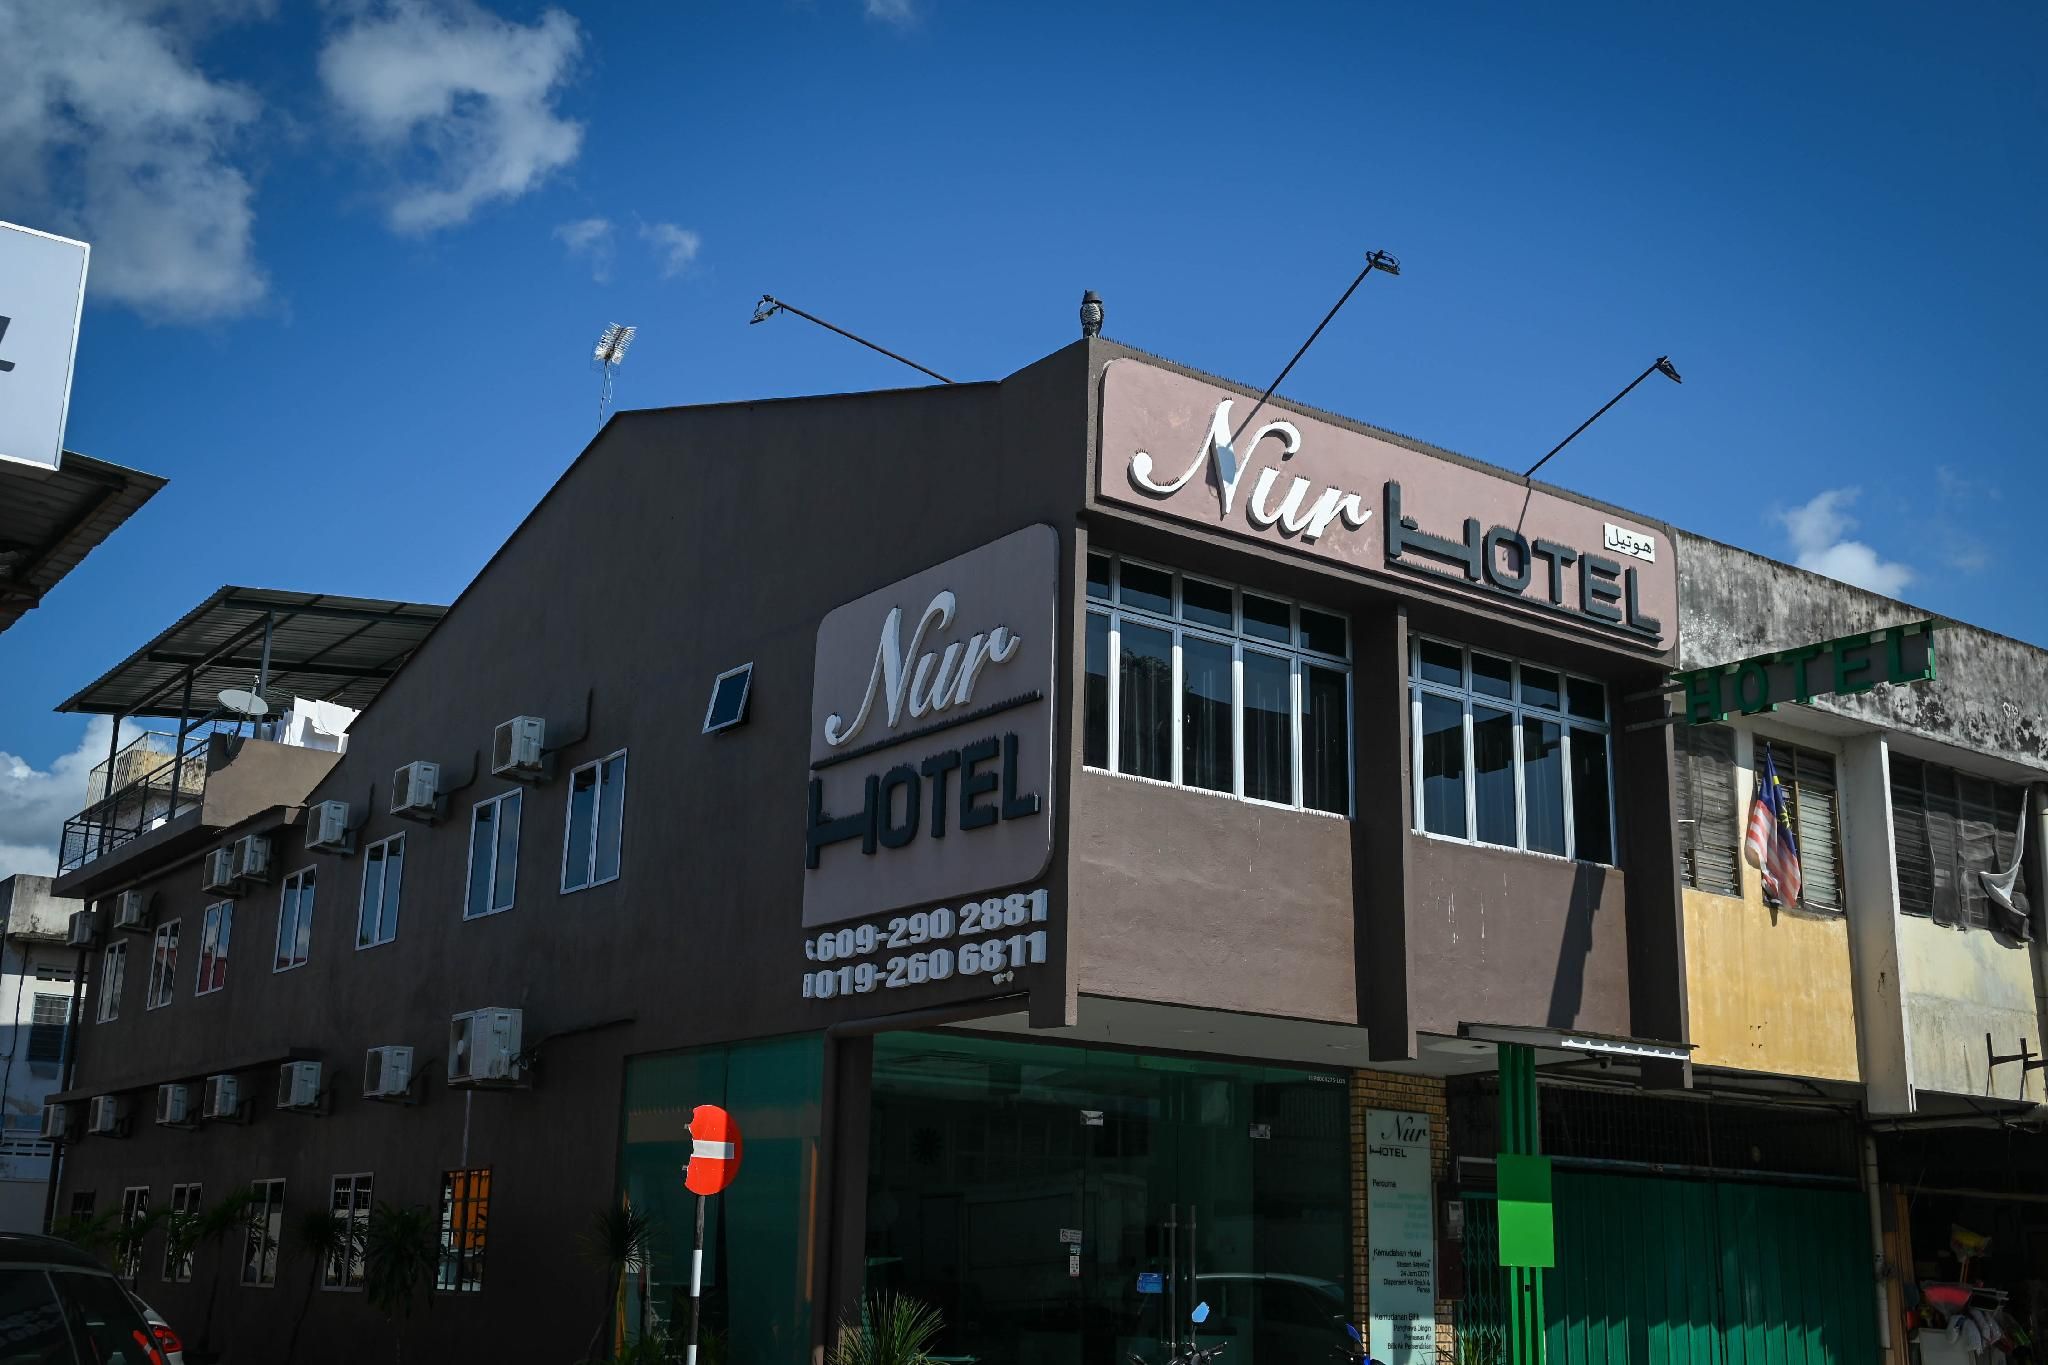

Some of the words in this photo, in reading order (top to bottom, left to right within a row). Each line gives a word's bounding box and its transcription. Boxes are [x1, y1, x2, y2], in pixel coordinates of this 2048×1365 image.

[1128, 398, 1373, 540] Nur
[1383, 480, 1663, 633] HOTEL
[1608, 528, 1652, 555] هوتيل
[824, 590, 1021, 746] Nur
[1685, 626, 1931, 725] HOTEL
[806, 731, 1042, 870] HOTEL
[816, 906, 956, 962] 609-290
[959, 887, 1049, 936] 2881
[815, 947, 955, 1000] 019-260
[958, 930, 1047, 975] 6811
[1369, 1144, 1407, 1158] HOTEL
[1381, 1114, 1428, 1141] Nur
